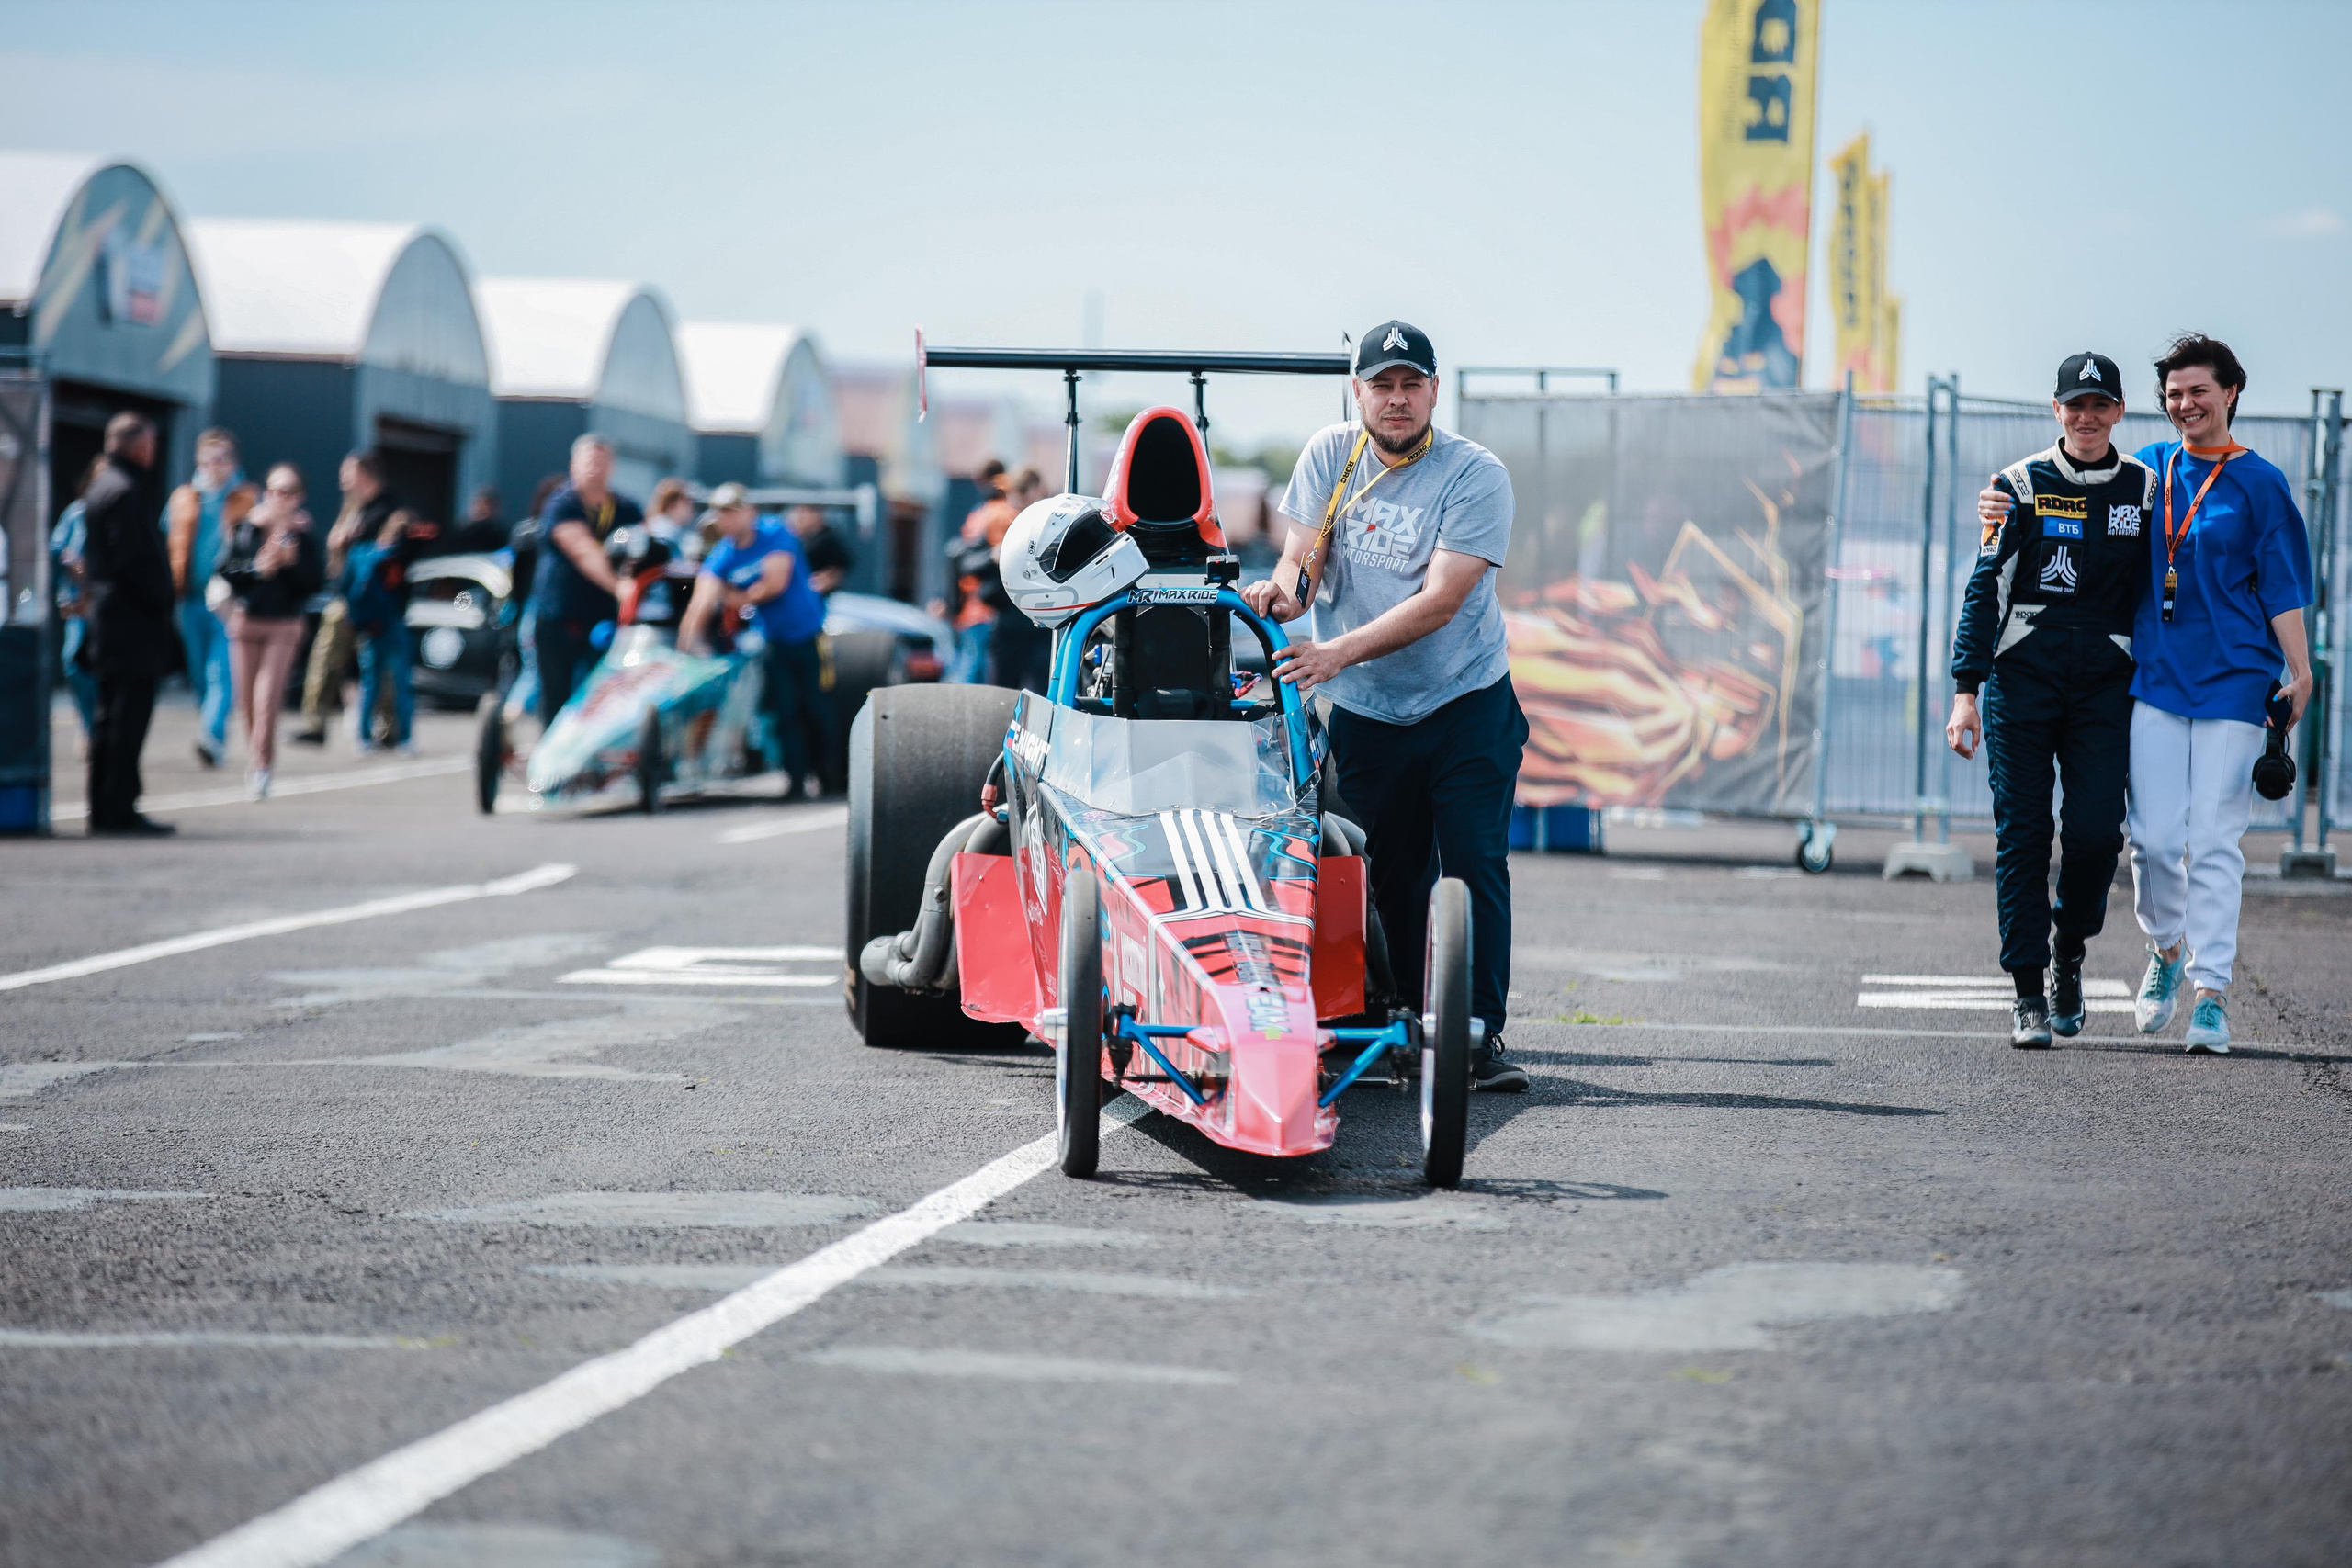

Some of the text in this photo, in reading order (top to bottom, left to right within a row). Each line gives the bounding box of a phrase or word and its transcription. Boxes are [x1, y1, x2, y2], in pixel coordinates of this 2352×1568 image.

[1408, 445, 1427, 461] RDRC
[1340, 460, 1354, 484] RDRC
[2038, 497, 2086, 513] RDRC
[2109, 504, 2141, 518] MAX
[1347, 491, 1424, 536] MAX
[2058, 523, 2079, 535] ВТБ
[2108, 528, 2139, 537] MOTORSPORT
[1342, 545, 1408, 573] MTORSPORT
